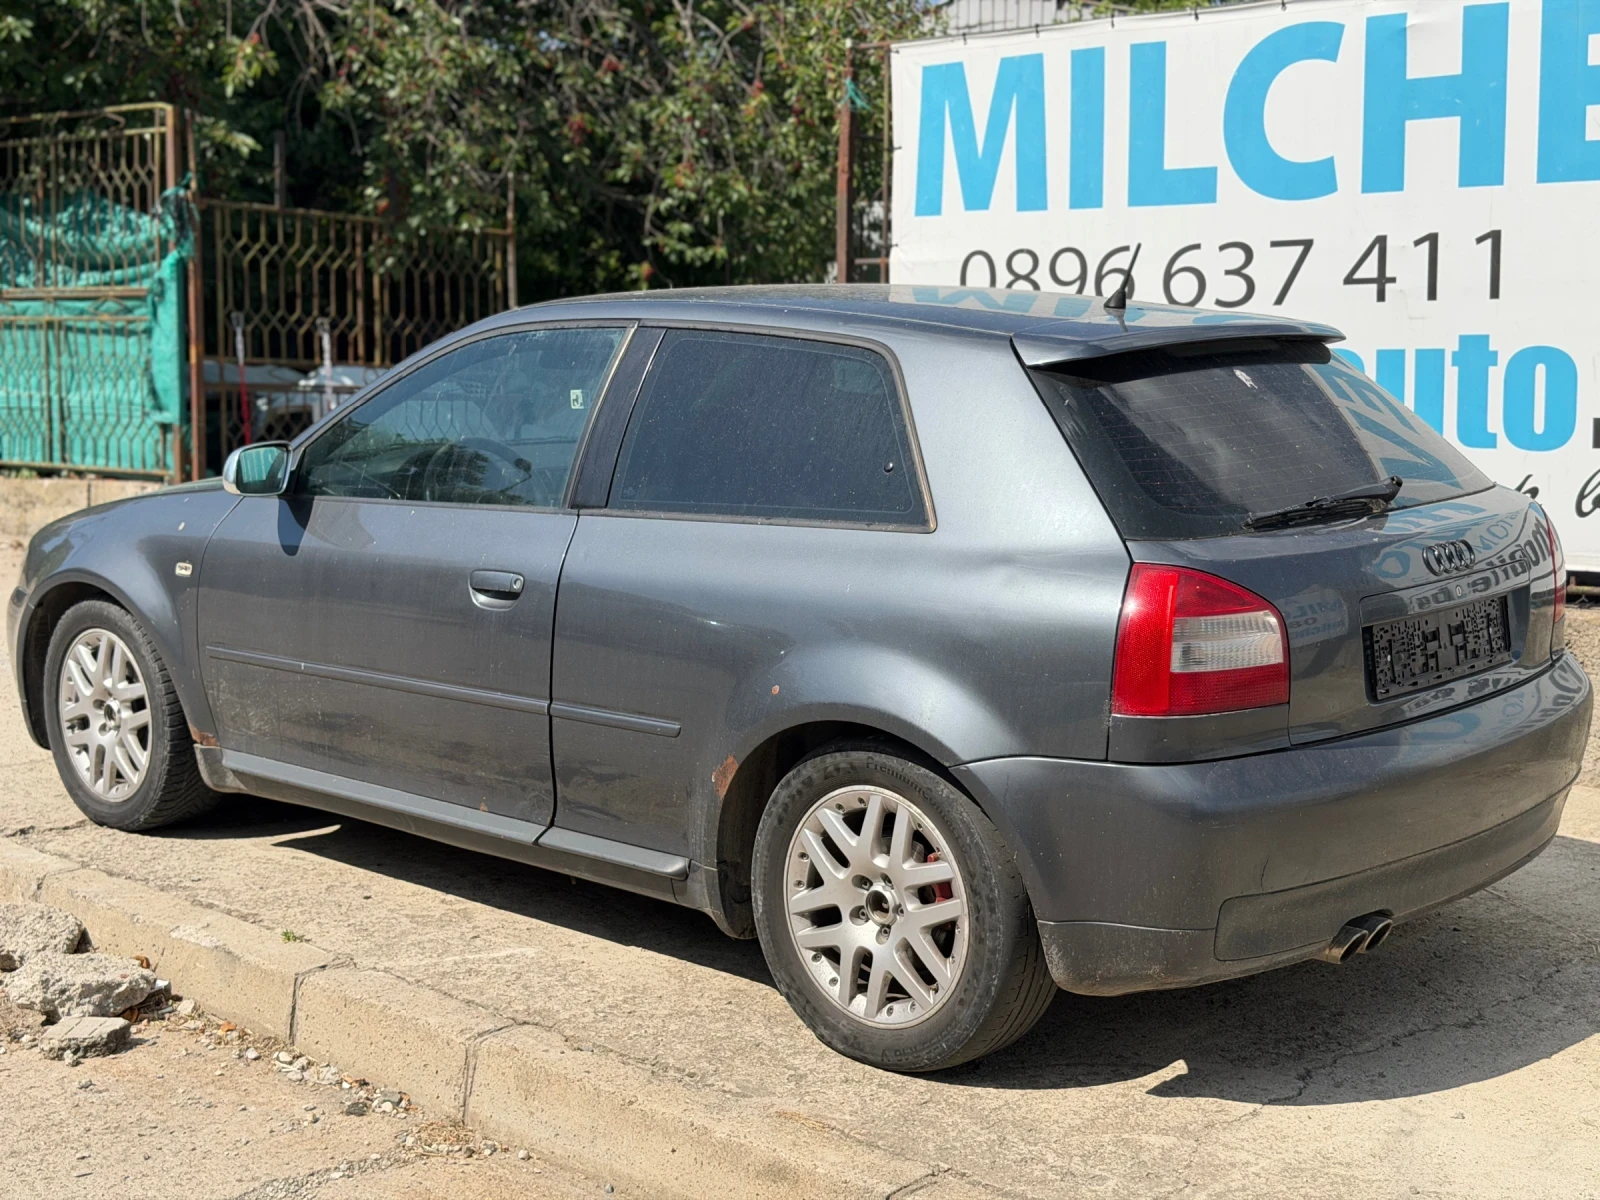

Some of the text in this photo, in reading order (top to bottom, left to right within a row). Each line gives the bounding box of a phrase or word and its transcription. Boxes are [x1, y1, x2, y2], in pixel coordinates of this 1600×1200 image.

[913, 0, 1600, 216] MILCHE
[960, 229, 1502, 308] 0896 637 411
